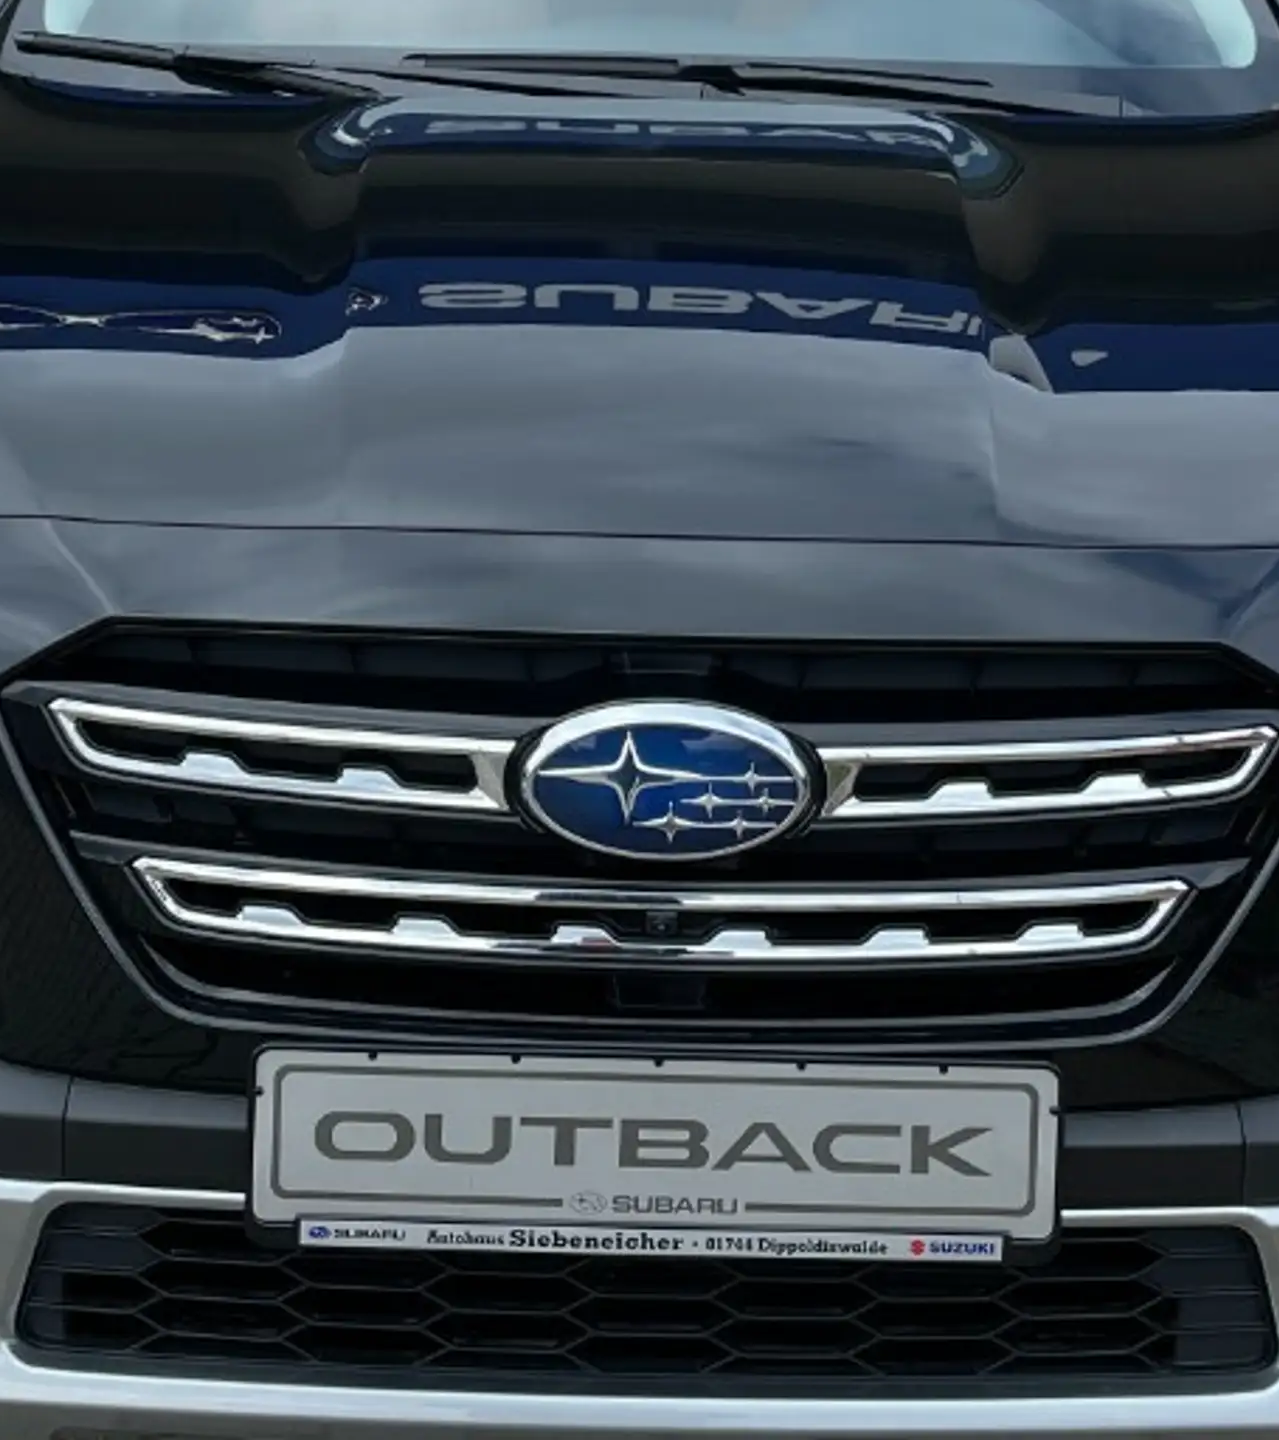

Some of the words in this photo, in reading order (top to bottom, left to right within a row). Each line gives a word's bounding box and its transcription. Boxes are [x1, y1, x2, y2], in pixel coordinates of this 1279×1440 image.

[314, 1110, 995, 1178] OUTBACK
[611, 1194, 738, 1216] SUBARU
[333, 1228, 407, 1242] SUBARU
[426, 1229, 505, 1246] Autohaus
[508, 1228, 685, 1253] Siebeneicher
[929, 1242, 995, 1256] SUZUKI
